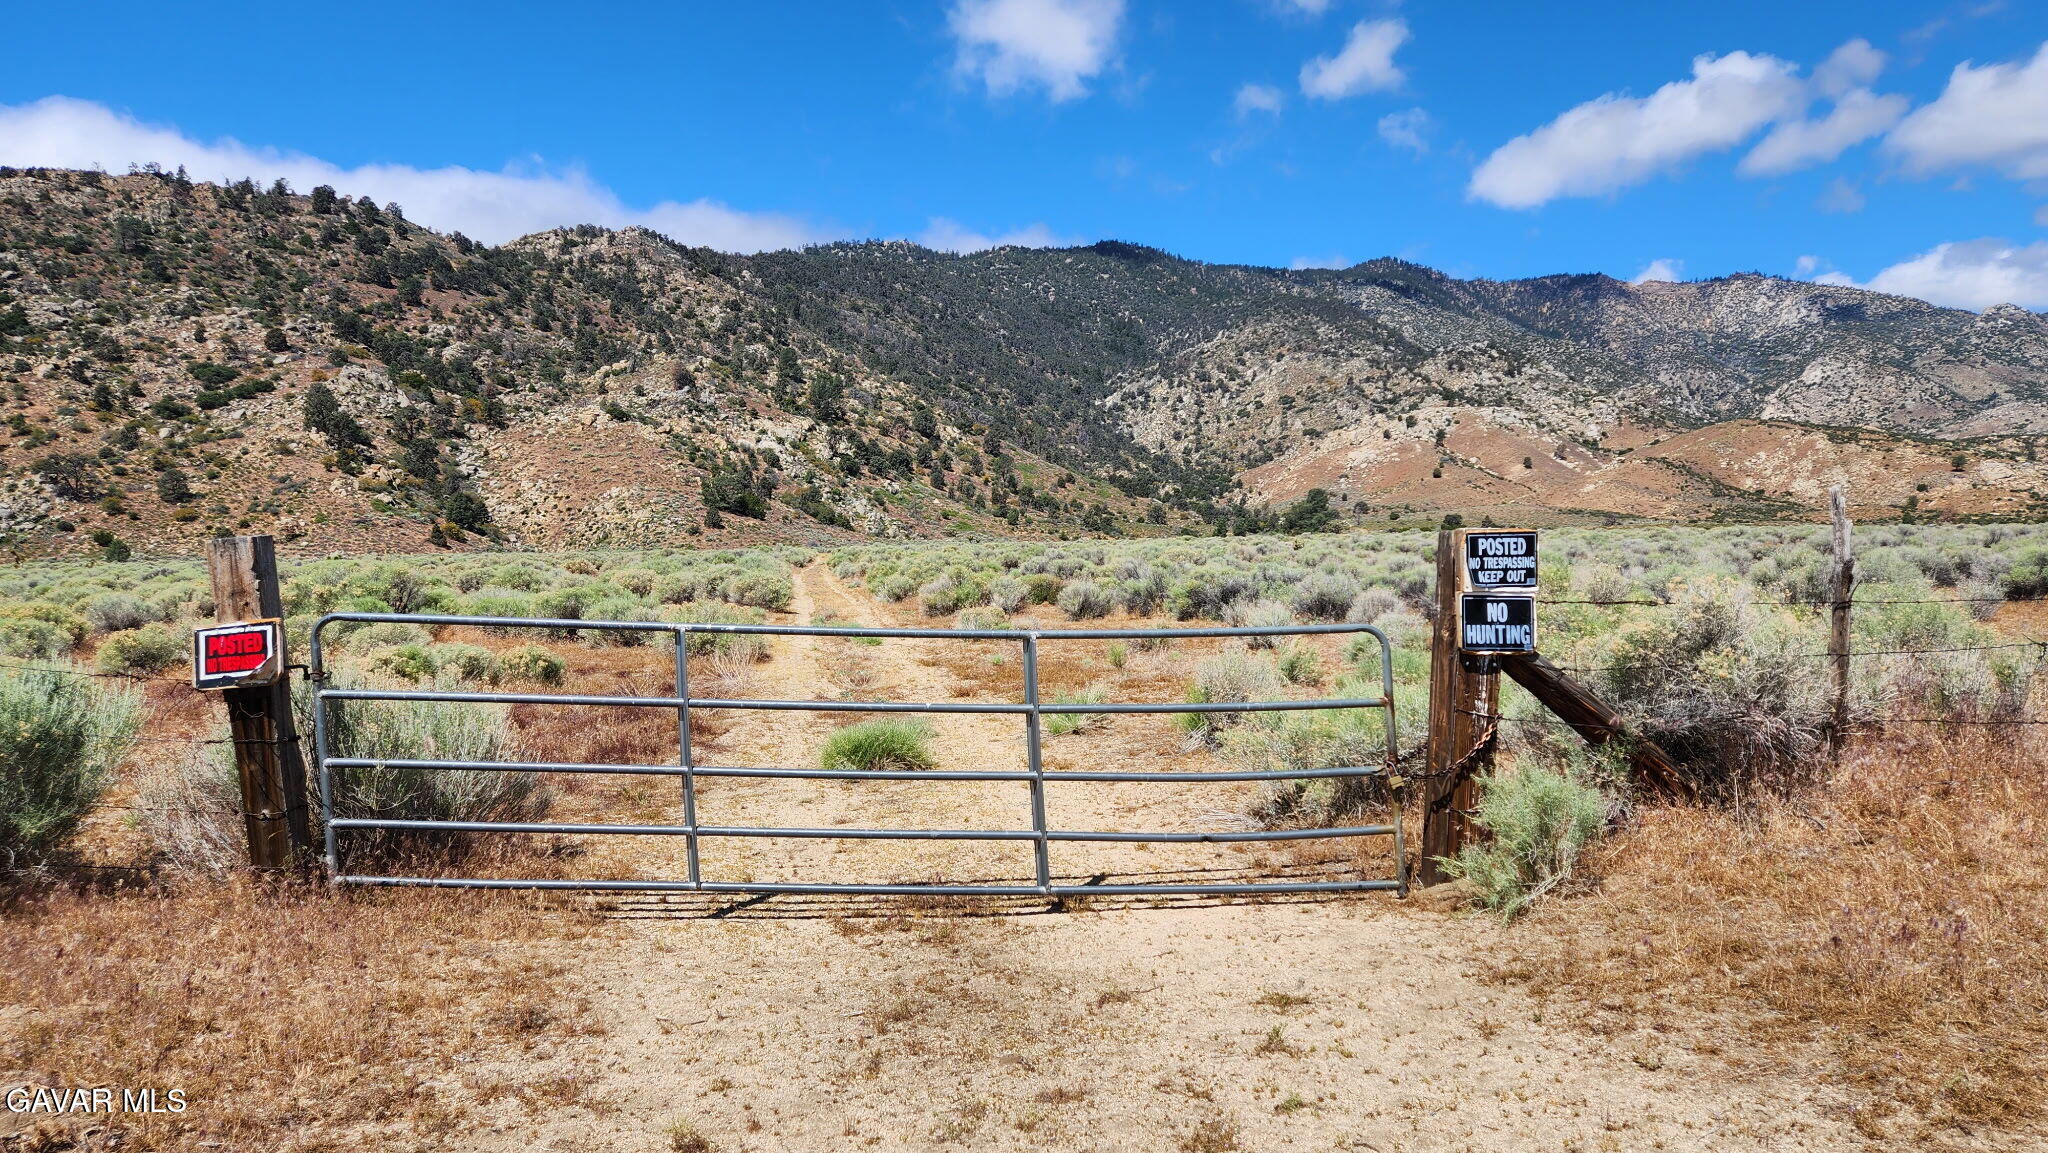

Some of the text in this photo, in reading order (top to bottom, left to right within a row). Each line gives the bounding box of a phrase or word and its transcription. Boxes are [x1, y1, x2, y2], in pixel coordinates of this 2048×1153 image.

[1478, 537, 1527, 556] POSTED
[1469, 556, 1535, 570] NO TRESPASSING
[1478, 570, 1526, 583] KEEP OUT
[1486, 602, 1508, 623] NO
[208, 632, 263, 656] POSTED
[1466, 624, 1531, 645] HUNTING
